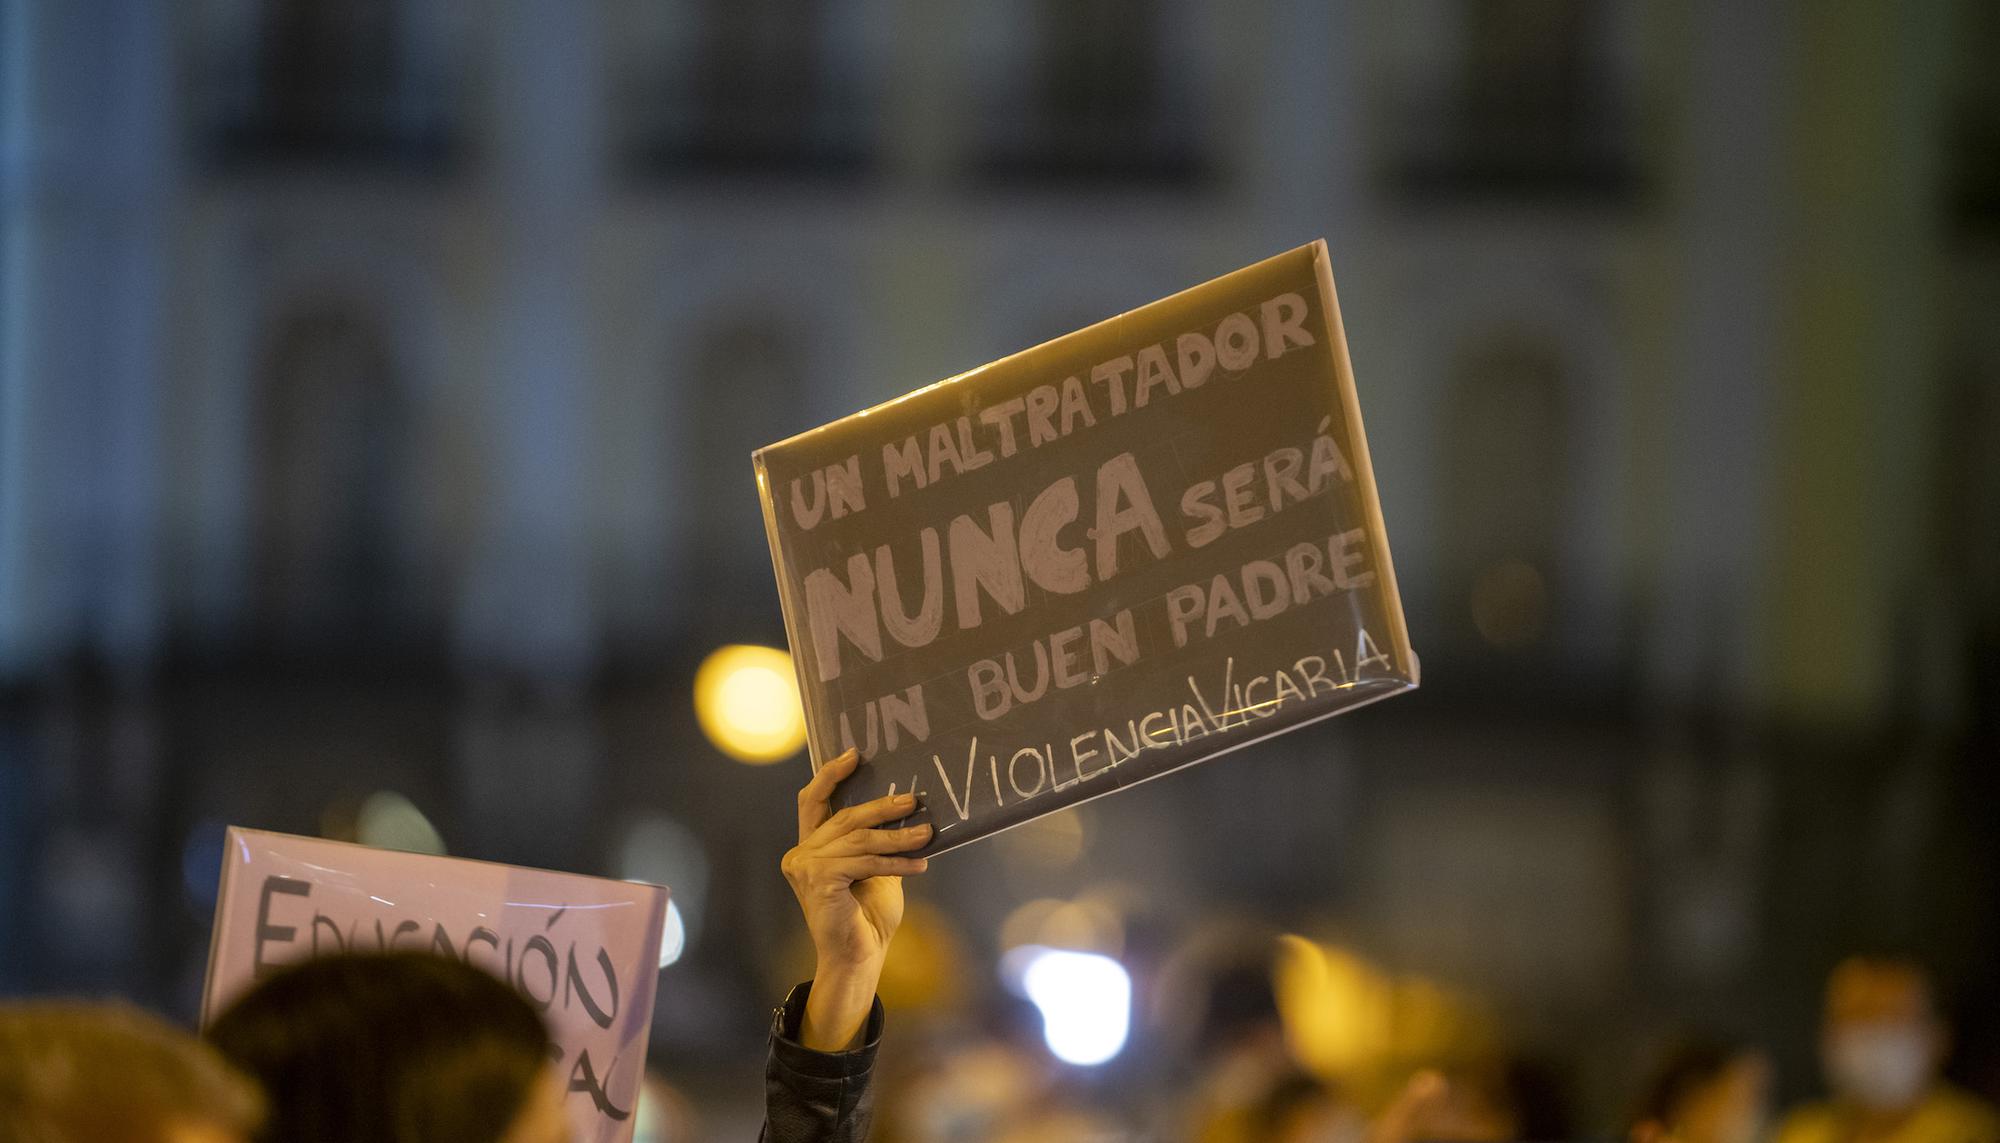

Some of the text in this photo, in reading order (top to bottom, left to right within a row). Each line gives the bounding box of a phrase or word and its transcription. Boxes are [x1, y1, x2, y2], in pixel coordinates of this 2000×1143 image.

[789, 292, 1316, 530] UN MALTRATADOR
[803, 415, 1355, 682] NUNCA SERÁ
[840, 529, 1375, 763] UN BUEN PADRE
